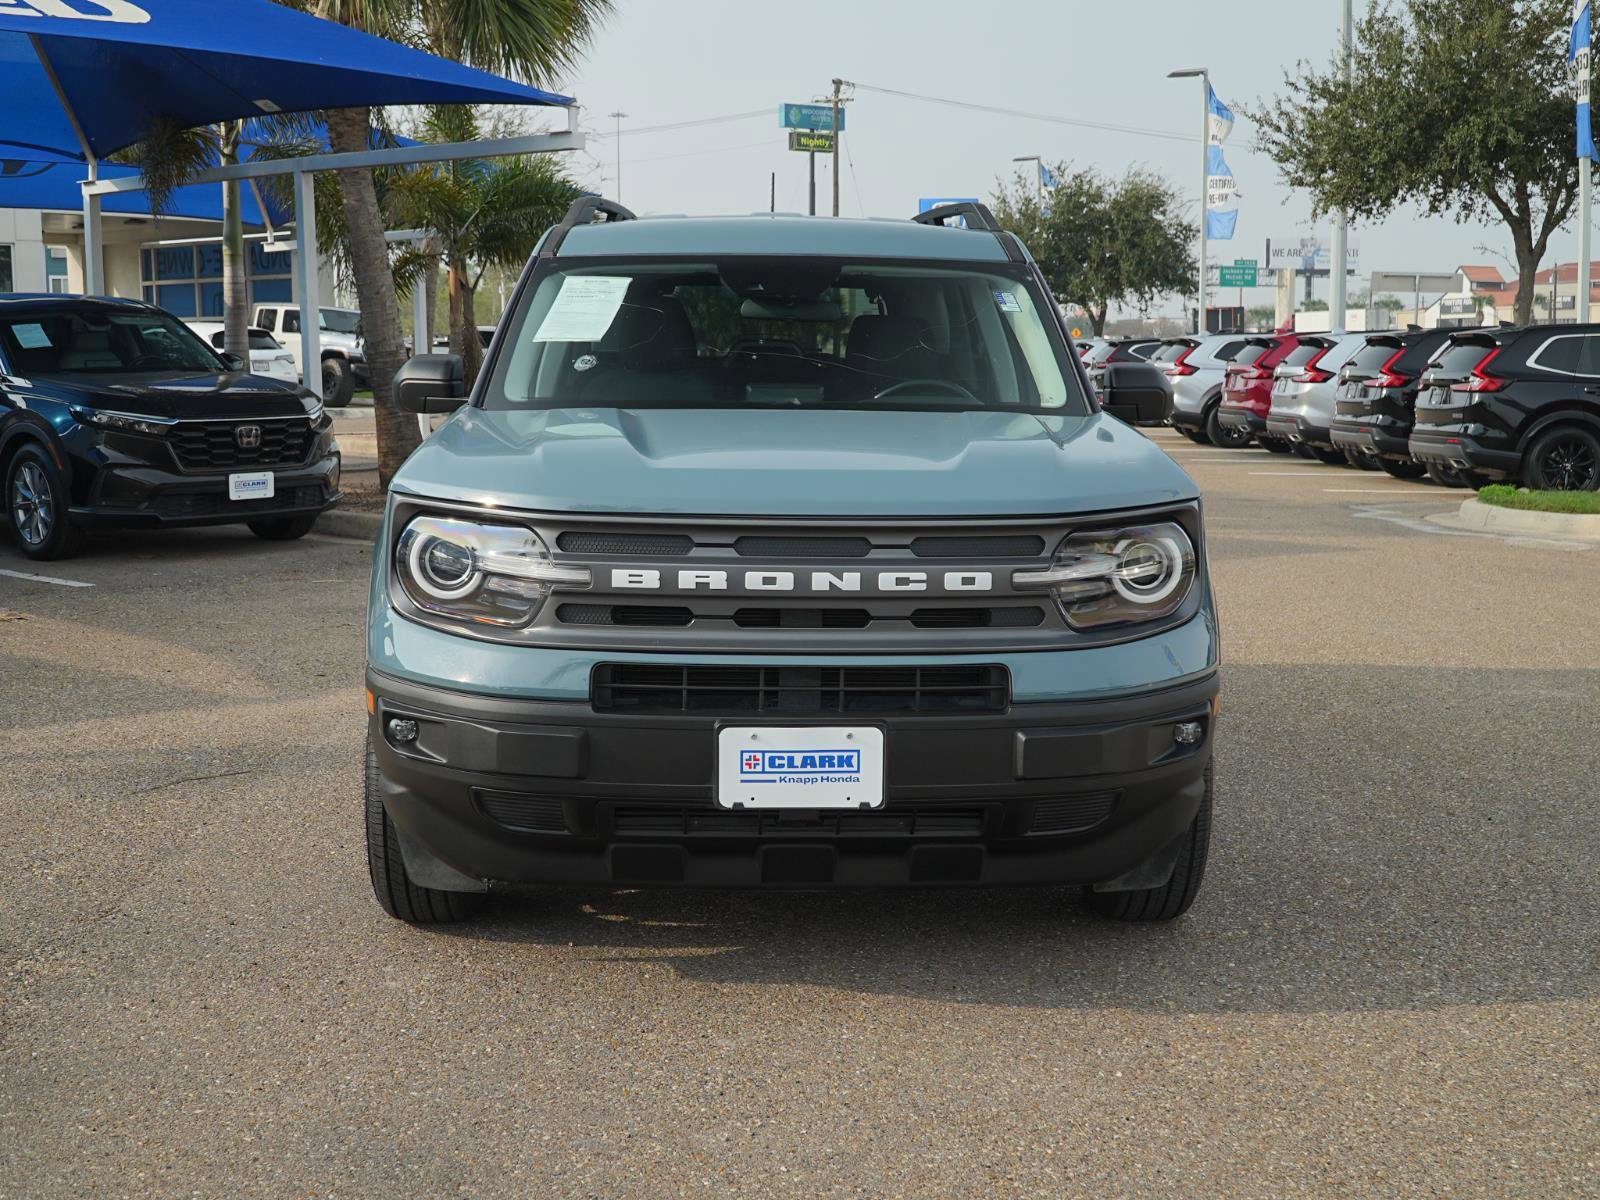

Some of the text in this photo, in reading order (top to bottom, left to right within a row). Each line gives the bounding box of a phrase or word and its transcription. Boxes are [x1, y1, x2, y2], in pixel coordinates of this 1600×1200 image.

[801, 137, 829, 148] Nightly
[1272, 249, 1286, 257] WE
[611, 569, 993, 591] BRONCO
[768, 755, 854, 768] CLARK
[779, 775, 860, 785] Knapp Honda
